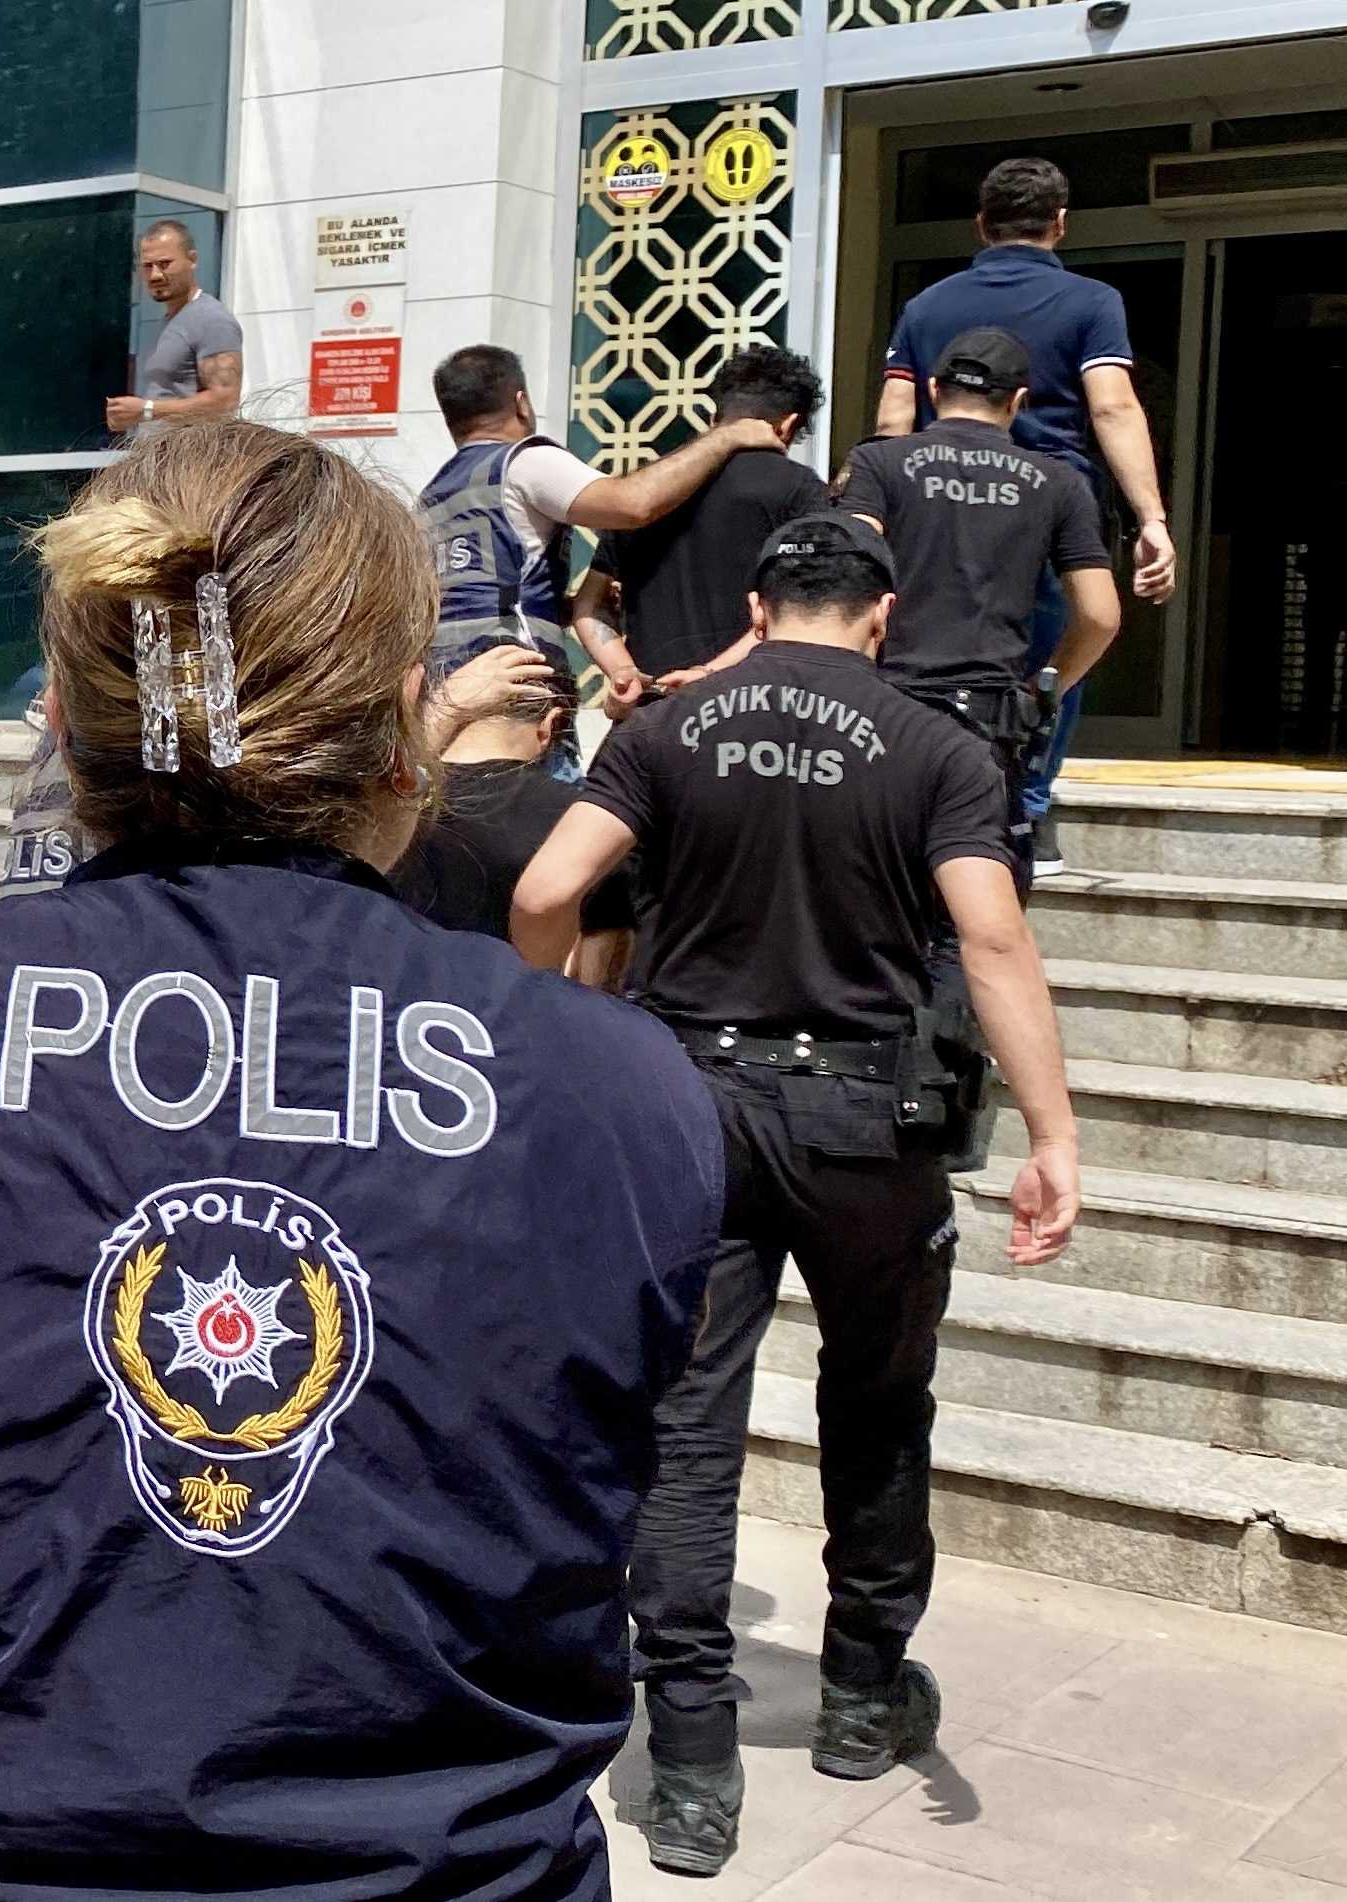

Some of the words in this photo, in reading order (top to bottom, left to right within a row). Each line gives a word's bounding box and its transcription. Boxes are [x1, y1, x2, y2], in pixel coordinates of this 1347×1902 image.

[318, 230, 382, 243] BEKLEMEK
[390, 228, 406, 238] VE
[327, 221, 344, 231] BU
[350, 216, 399, 228] ALANDA
[961, 449, 1048, 490] KUVVET
[780, 686, 887, 763] KUVVET
